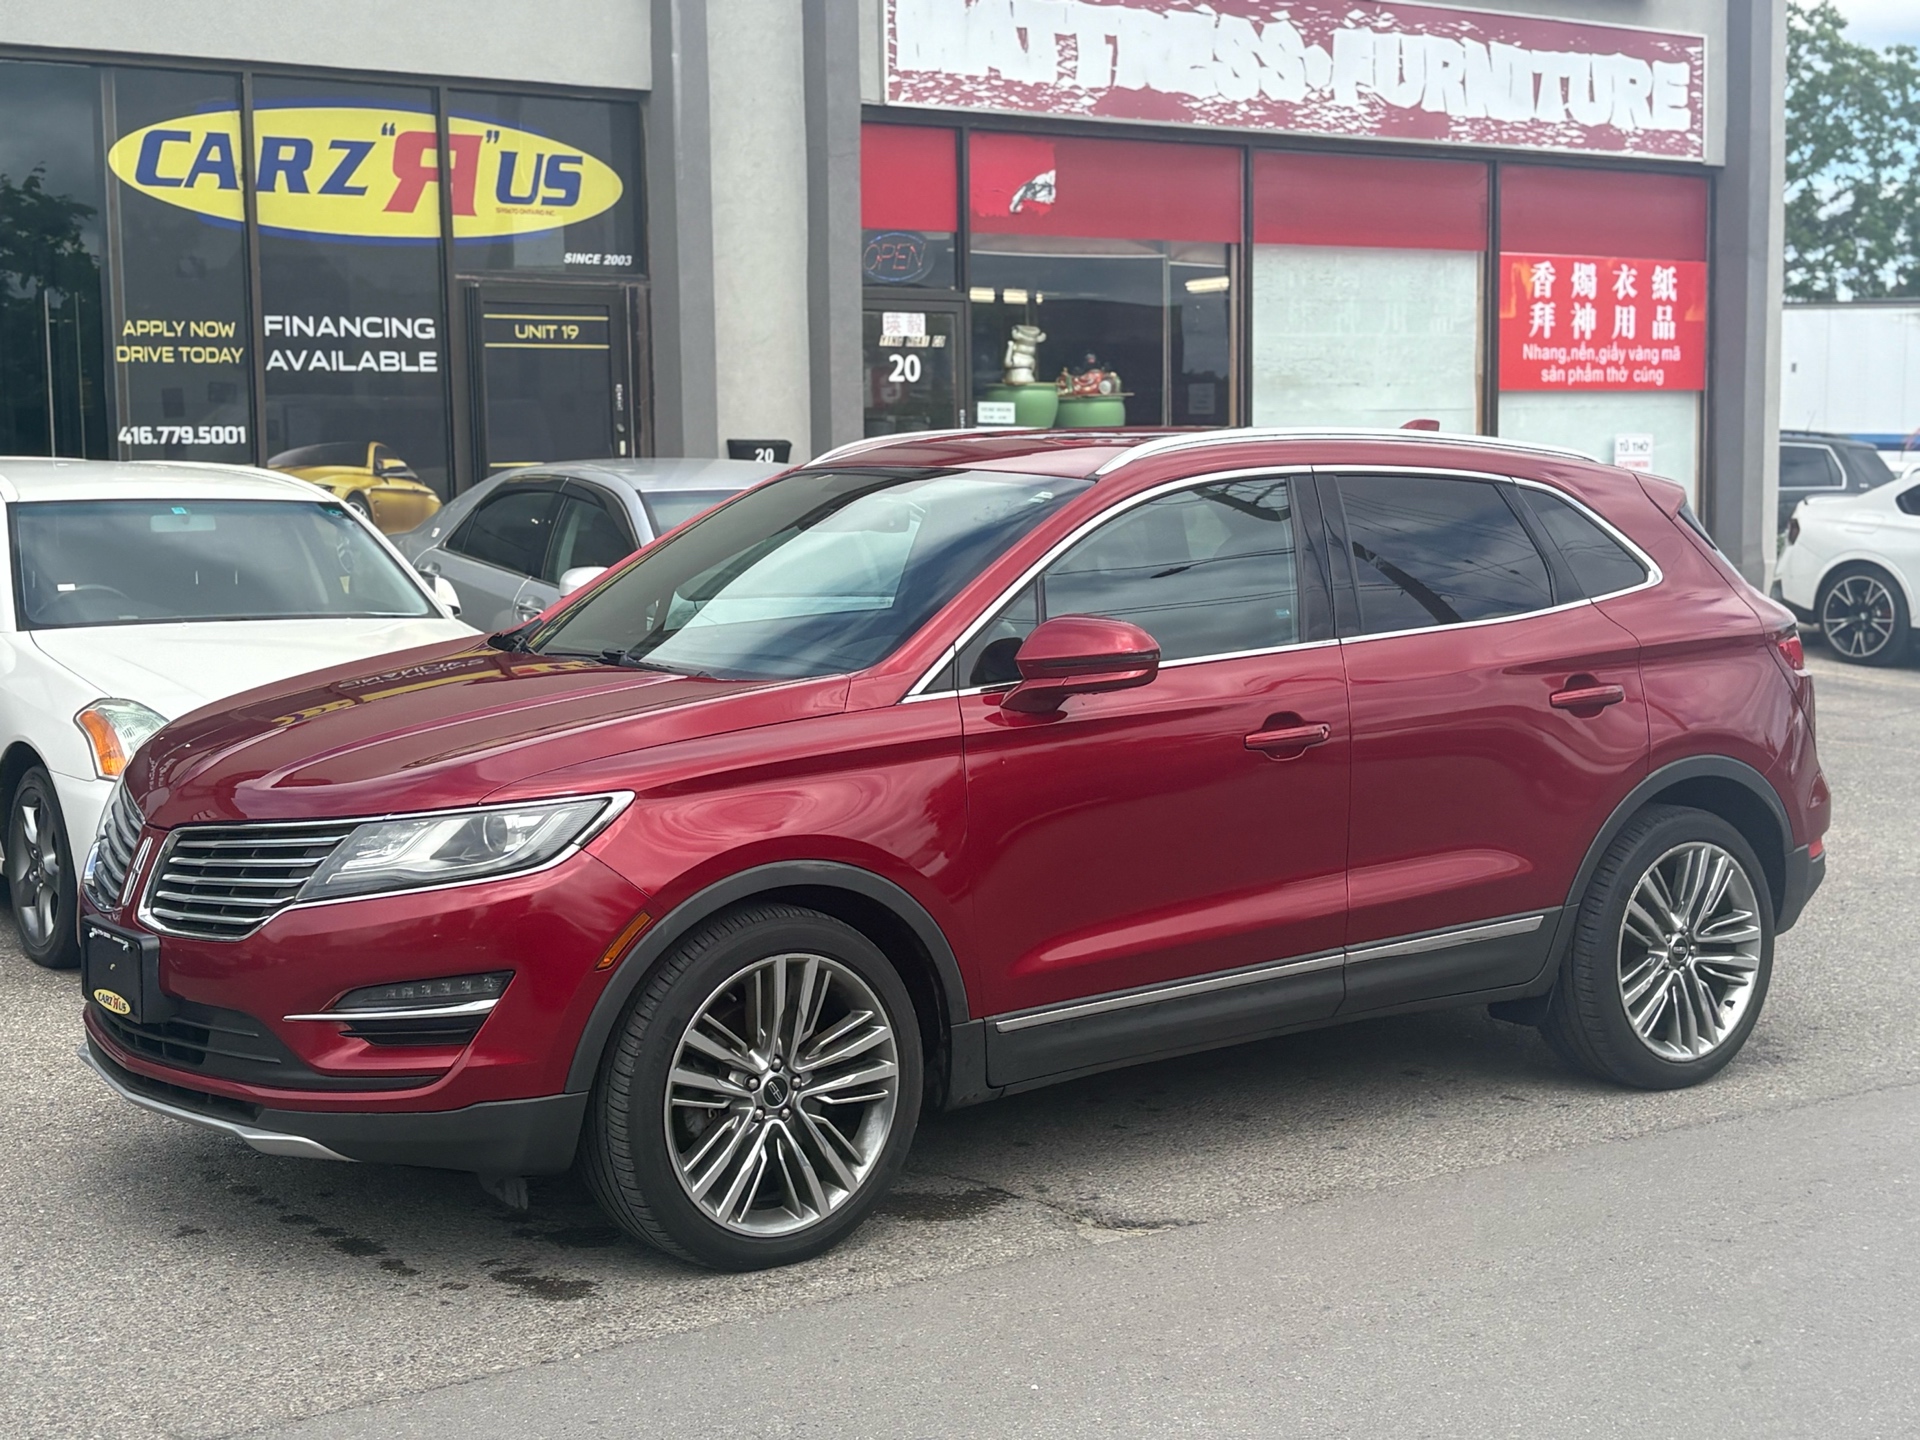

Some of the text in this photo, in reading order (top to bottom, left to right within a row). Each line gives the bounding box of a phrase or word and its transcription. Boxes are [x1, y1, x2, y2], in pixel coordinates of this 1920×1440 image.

[1328, 27, 1691, 131] FURNITURE
[135, 129, 376, 196] CARZ
[496, 151, 583, 206] US
[564, 253, 632, 266] SINCE 2003
[863, 243, 926, 271] OPEN
[122, 320, 236, 338] APPLY NOW
[264, 315, 436, 339] FINANCING
[514, 324, 579, 340] UNIT 19
[1528, 302, 1677, 340] 拜神用品
[116, 345, 244, 364] DRIVE TODAY
[266, 349, 438, 372] AVAILABLE
[888, 354, 921, 383] 20
[117, 426, 246, 445] 416.779.5001
[755, 448, 774, 463] 20
